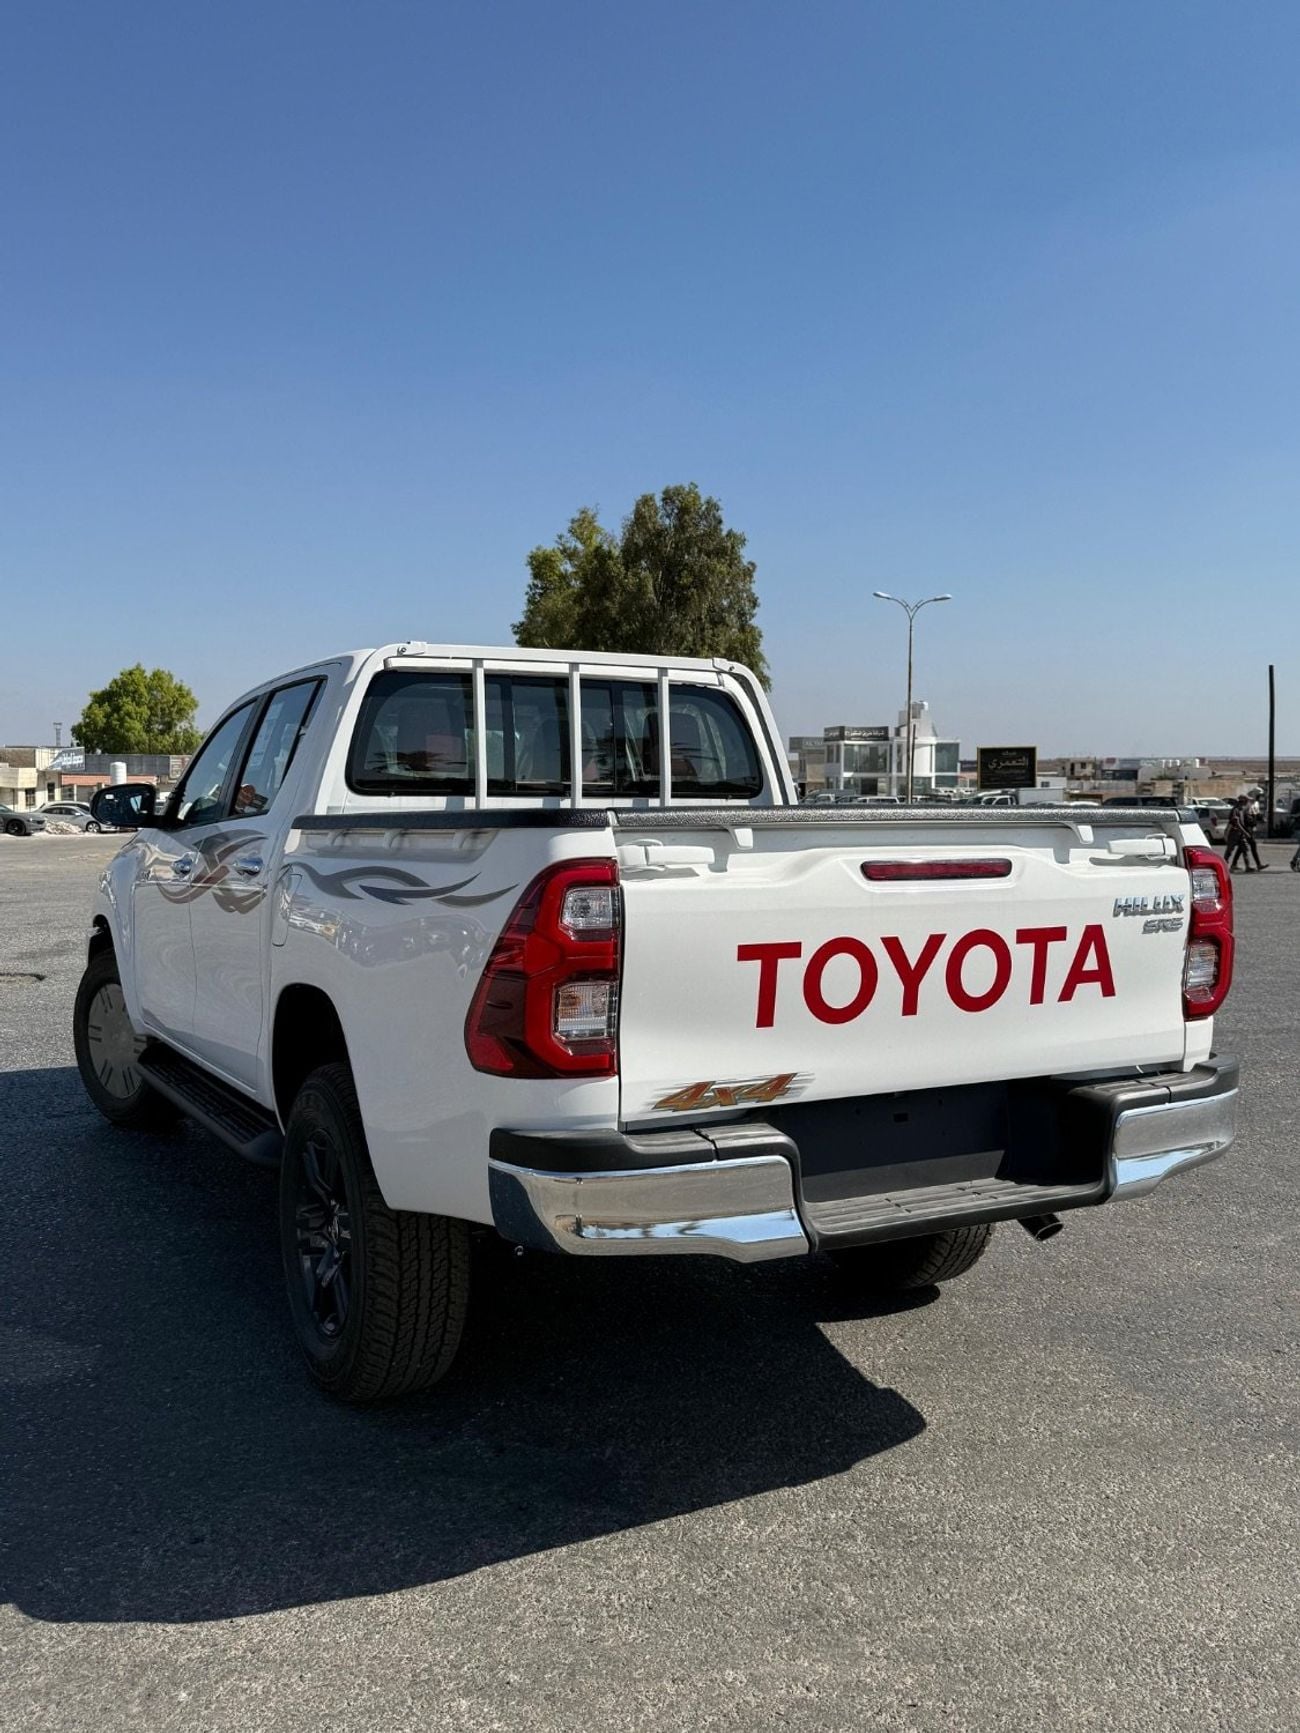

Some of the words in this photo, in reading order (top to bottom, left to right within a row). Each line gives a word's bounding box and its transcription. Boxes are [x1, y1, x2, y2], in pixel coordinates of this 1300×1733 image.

[1112, 894, 1184, 918] HILUX
[737, 924, 1116, 1028] TOYOTA
[651, 1073, 797, 1112] 4x4
